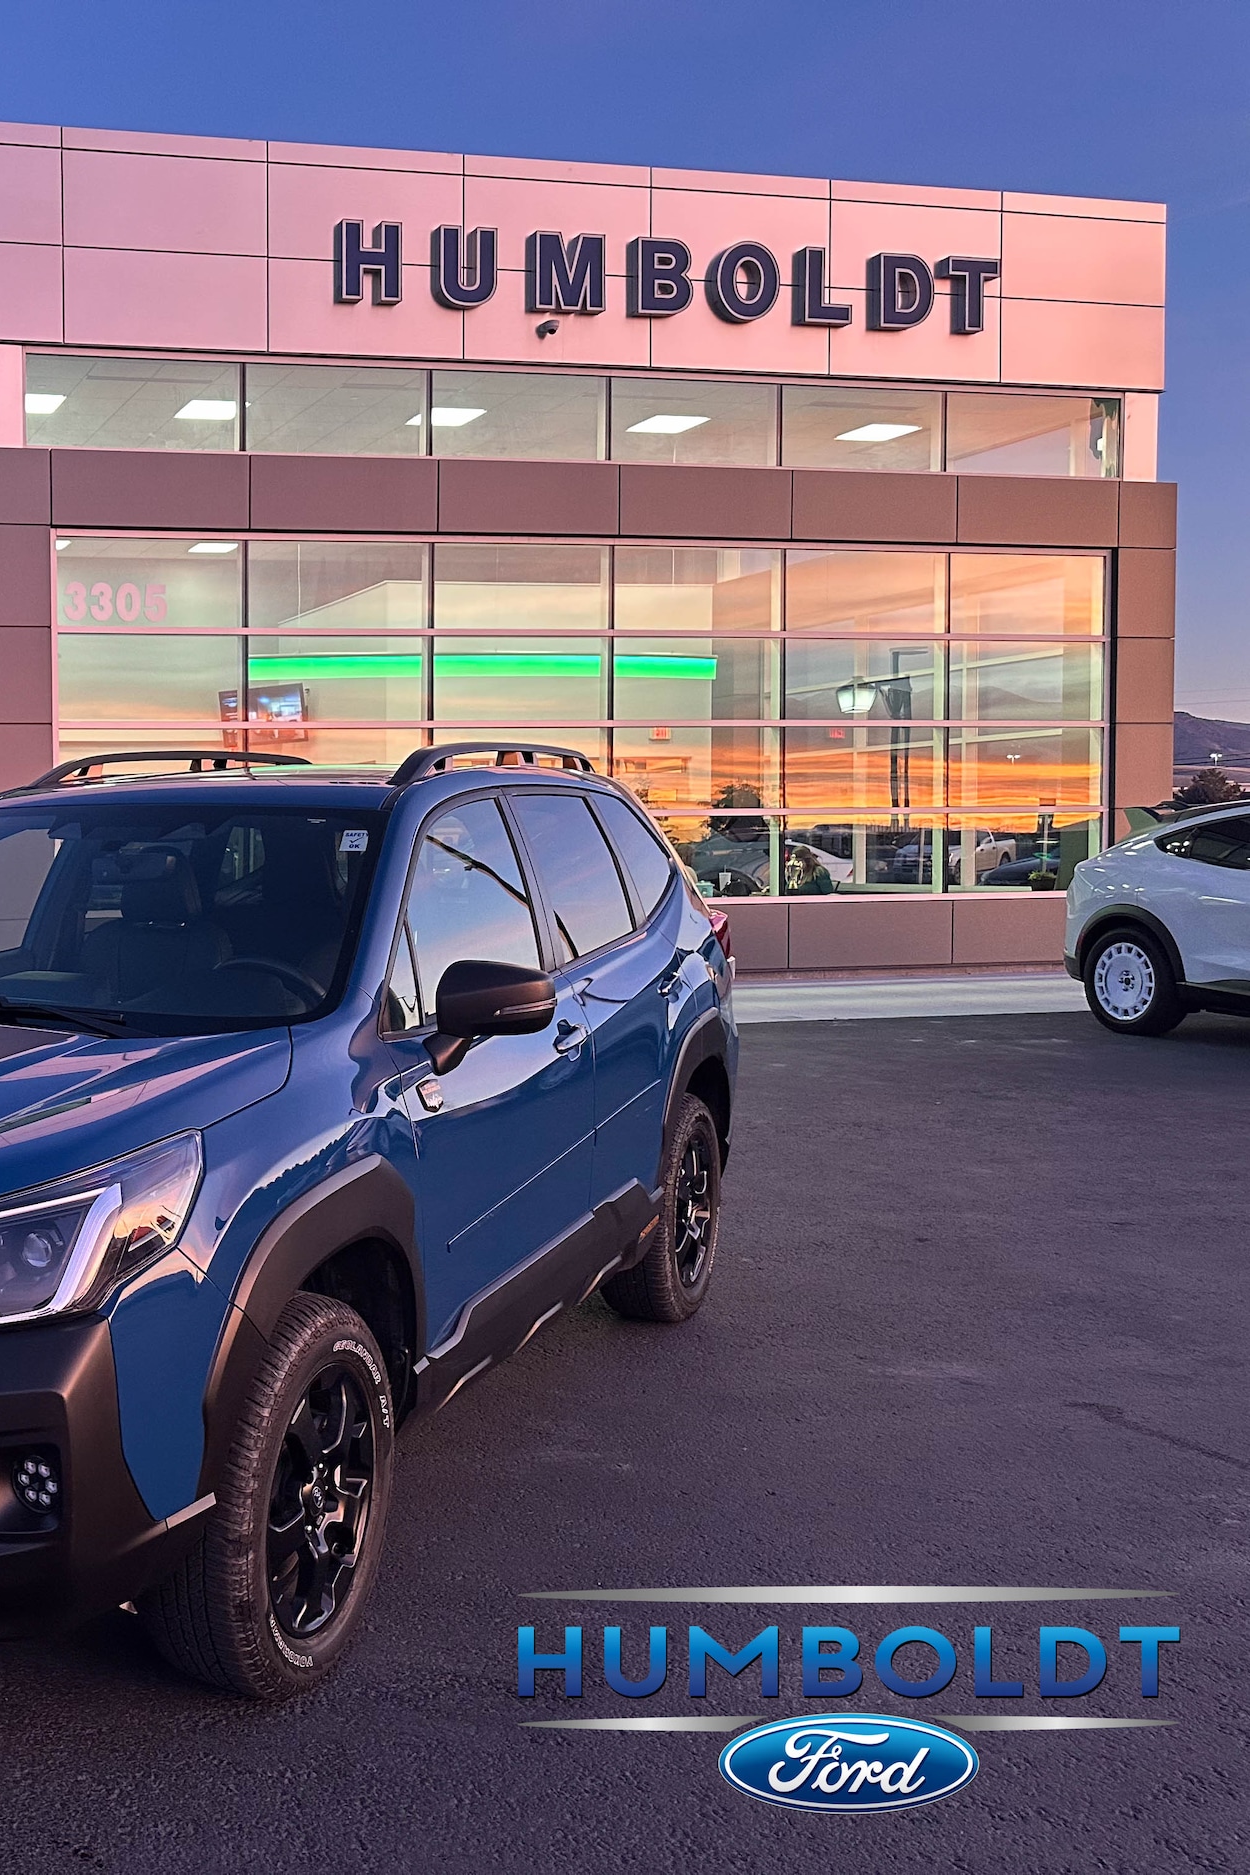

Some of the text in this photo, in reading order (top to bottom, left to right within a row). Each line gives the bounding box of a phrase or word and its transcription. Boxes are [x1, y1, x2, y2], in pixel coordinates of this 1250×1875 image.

[333, 218, 1001, 335] HUMBOLDT
[63, 582, 168, 622] 3305
[333, 1340, 382, 1385] GEOLANDAR
